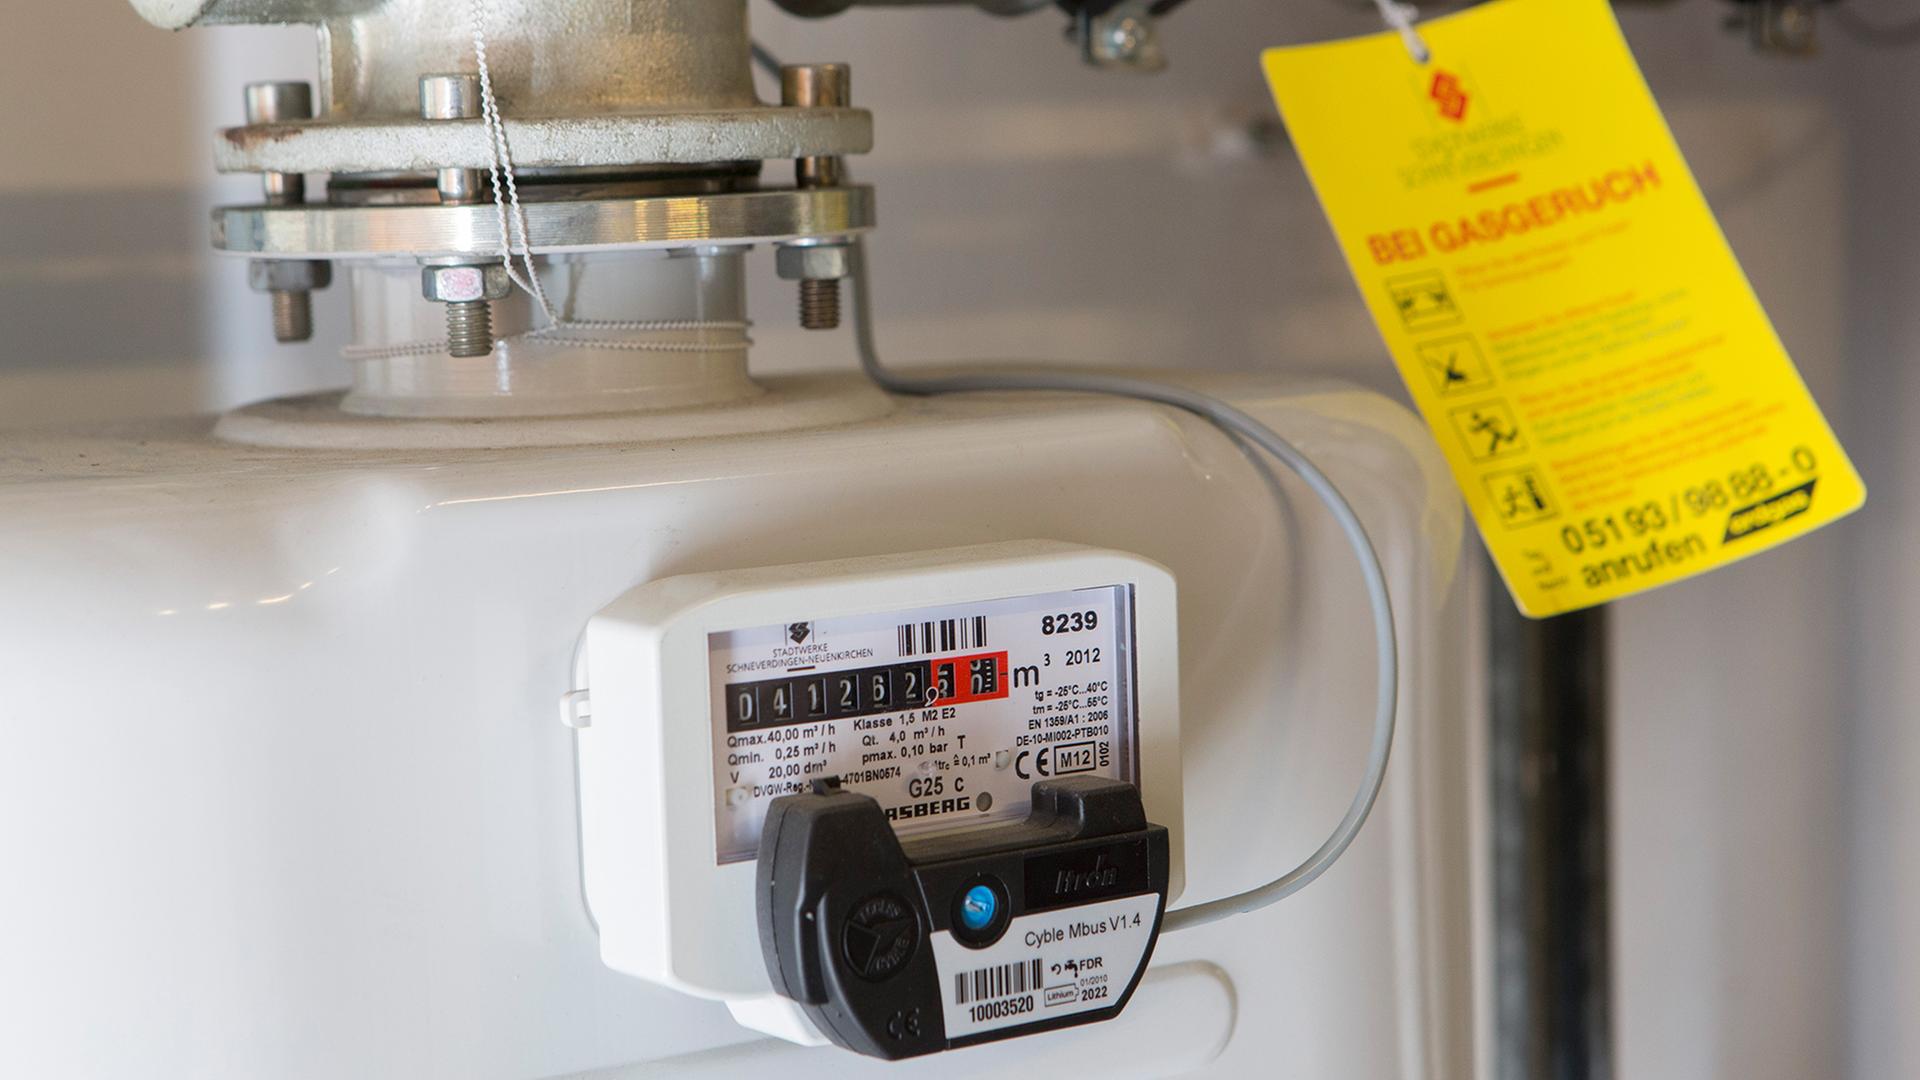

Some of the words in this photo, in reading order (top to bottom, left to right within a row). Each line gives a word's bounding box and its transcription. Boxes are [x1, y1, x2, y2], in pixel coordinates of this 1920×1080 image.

[1366, 228, 1427, 266] BEI
[1429, 159, 1662, 254] GASGERUCH
[1580, 530, 1708, 591] anrufen
[1041, 610, 1099, 636] 8239
[772, 643, 829, 658] STADTWERKE
[1065, 647, 1101, 667] 2012
[853, 717, 893, 731] Klasse
[899, 712, 915, 727] 1,5
[921, 710, 939, 723] M2
[941, 708, 956, 720] E2
[1028, 719, 1042, 730] EN
[1087, 710, 1109, 722] 2006
[1032, 705, 1045, 715] tm
[889, 730, 906, 745] 4,0
[727, 752, 765, 767] Qmin.
[775, 745, 800, 761] 0,25
[862, 751, 897, 766] pmax.
[900, 744, 924, 758] 0,10
[929, 742, 948, 754] bar
[957, 734, 966, 750] T
[1060, 749, 1091, 768] M12
[1098, 740, 1110, 767] 0102
[730, 771, 740, 784] V
[768, 763, 800, 780] 20,00
[908, 775, 944, 799] G25
[954, 777, 965, 793] C
[884, 796, 970, 821] ASBERG
[1024, 927, 1065, 949] Cyble
[1068, 920, 1107, 940] Mbus
[1109, 912, 1142, 932] V1.4
[1079, 956, 1104, 972] FDR
[1079, 974, 1109, 988] 01/2010
[968, 994, 1035, 1024] 10003520
[1081, 986, 1109, 1002] 2022
[1047, 988, 1075, 1002] Lithium
